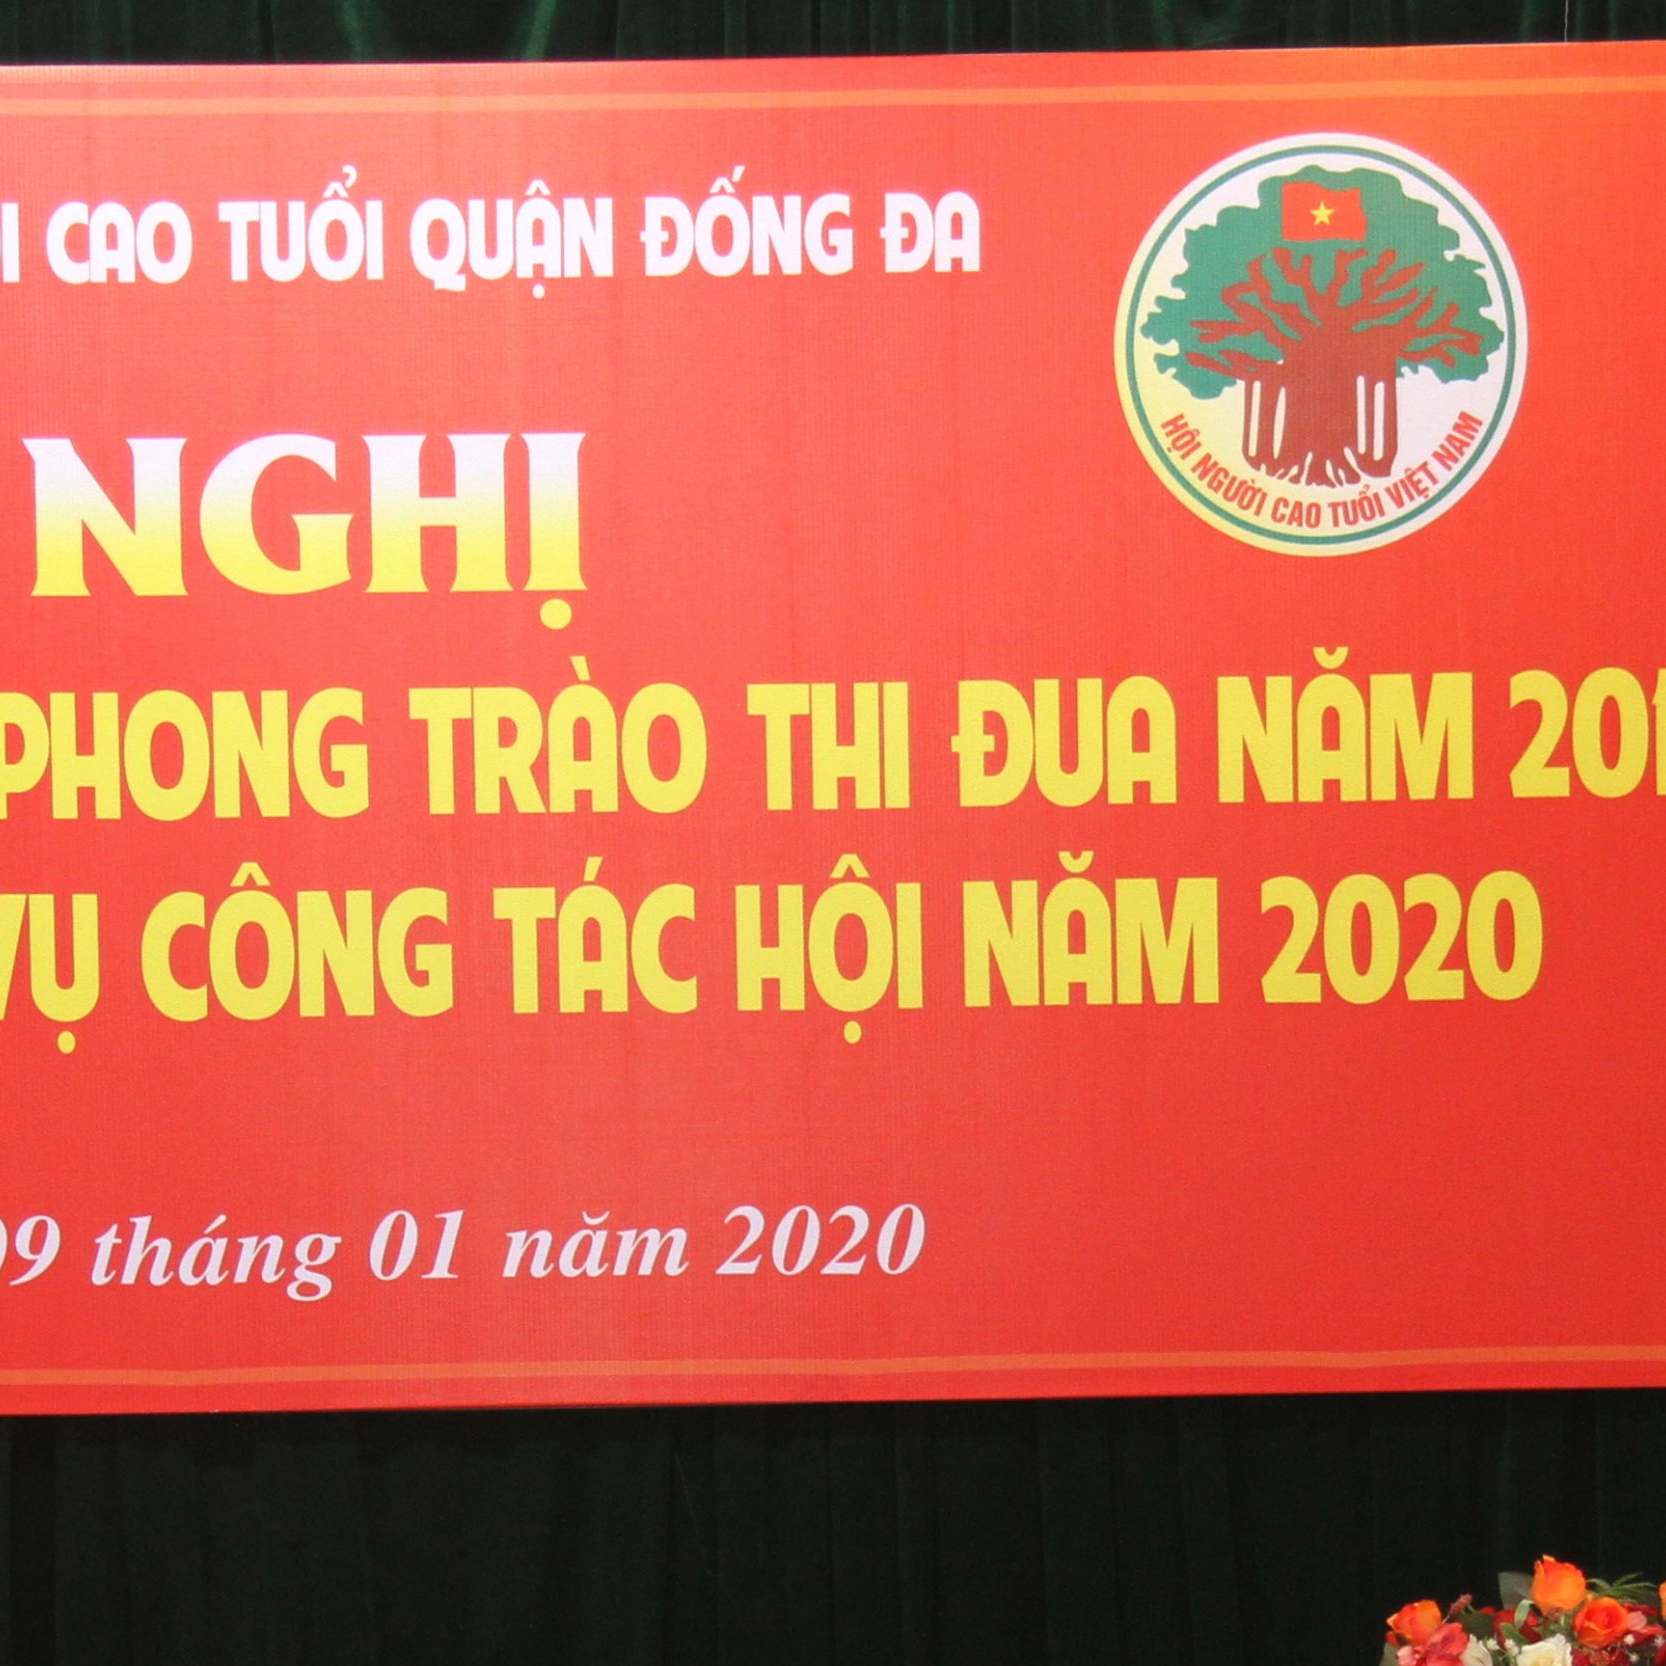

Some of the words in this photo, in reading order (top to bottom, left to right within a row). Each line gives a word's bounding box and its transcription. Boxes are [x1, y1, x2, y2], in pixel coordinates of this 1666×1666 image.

[46, 201, 192, 284] CAO
[218, 165, 384, 282] TUỔI
[410, 179, 613, 299] QUẬN
[640, 166, 853, 276] ĐỐNG
[880, 192, 980, 272] ĐA
[22, 431, 588, 630] NGHỊ
[1161, 413, 1202, 460] HỘI
[1191, 452, 1268, 517] NGƯỜI
[1270, 496, 1321, 529] CAO
[1328, 484, 1386, 527] TUỔI
[1385, 461, 1439, 509] VIỆT
[1432, 410, 1483, 472] NAM
[408, 655, 707, 815] TRÀO
[747, 681, 910, 810] THI
[951, 675, 1177, 807] ĐUA
[1217, 647, 1473, 803] NĂM
[141, 862, 453, 1021] CÔNG
[493, 856, 697, 1014] TÁC
[735, 854, 923, 1043] HỘI
[963, 851, 1219, 1007] NĂM
[1261, 871, 1542, 1004] 2020
[92, 1215, 341, 1301] tháng
[370, 1210, 463, 1280] 01
[503, 1211, 688, 1278] năm
[716, 1204, 925, 1275] 2020
